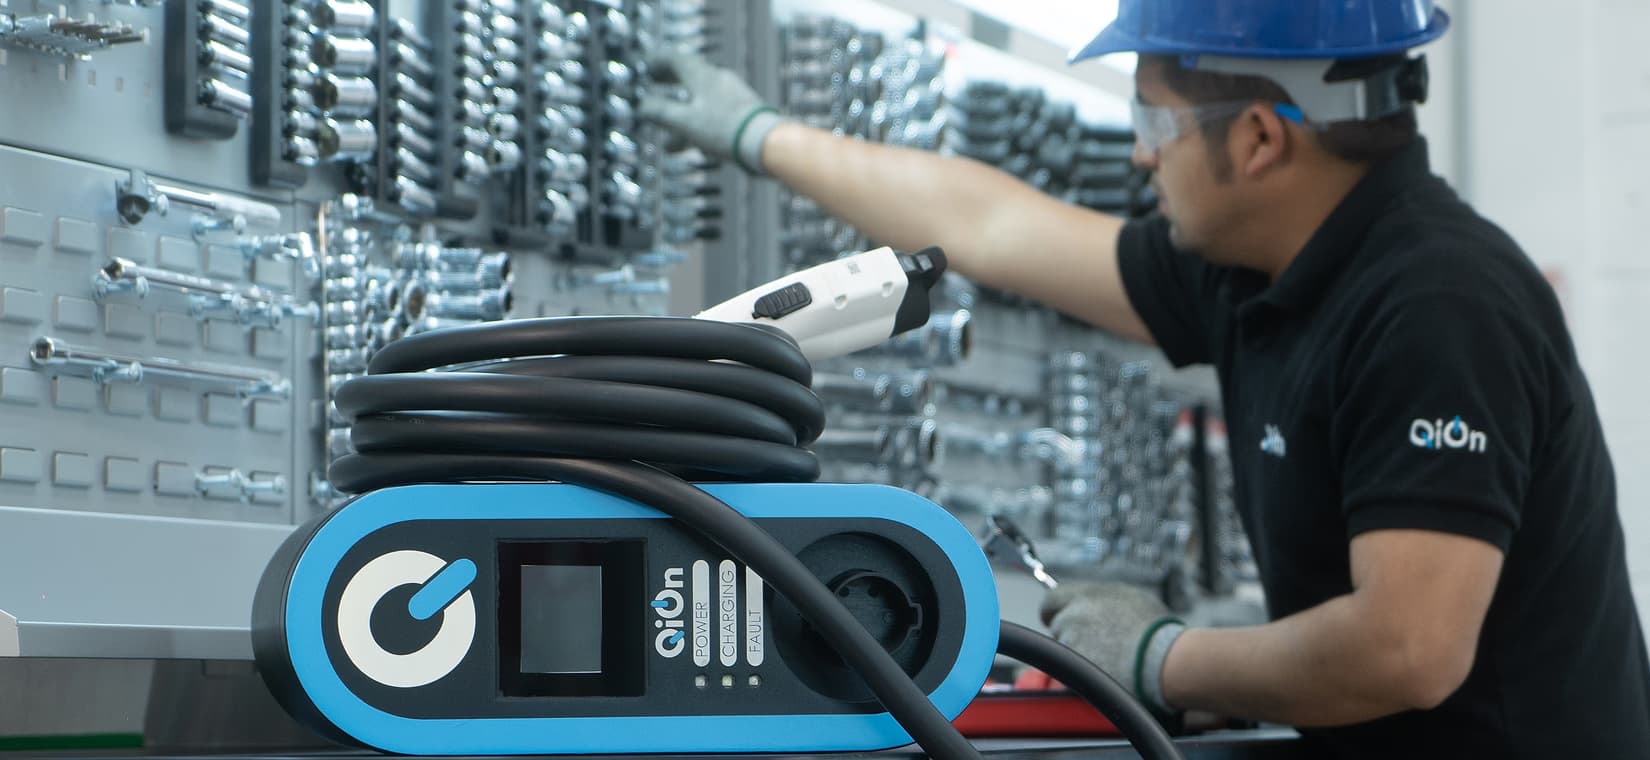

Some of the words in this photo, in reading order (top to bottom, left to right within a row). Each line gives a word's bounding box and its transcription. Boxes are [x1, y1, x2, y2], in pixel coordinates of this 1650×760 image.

[1409, 415, 1487, 453] QiOn
[650, 567, 685, 659] QiOn
[695, 601, 708, 657] POWER
[721, 570, 735, 658] CHARGING
[748, 609, 762, 653] FAULT
